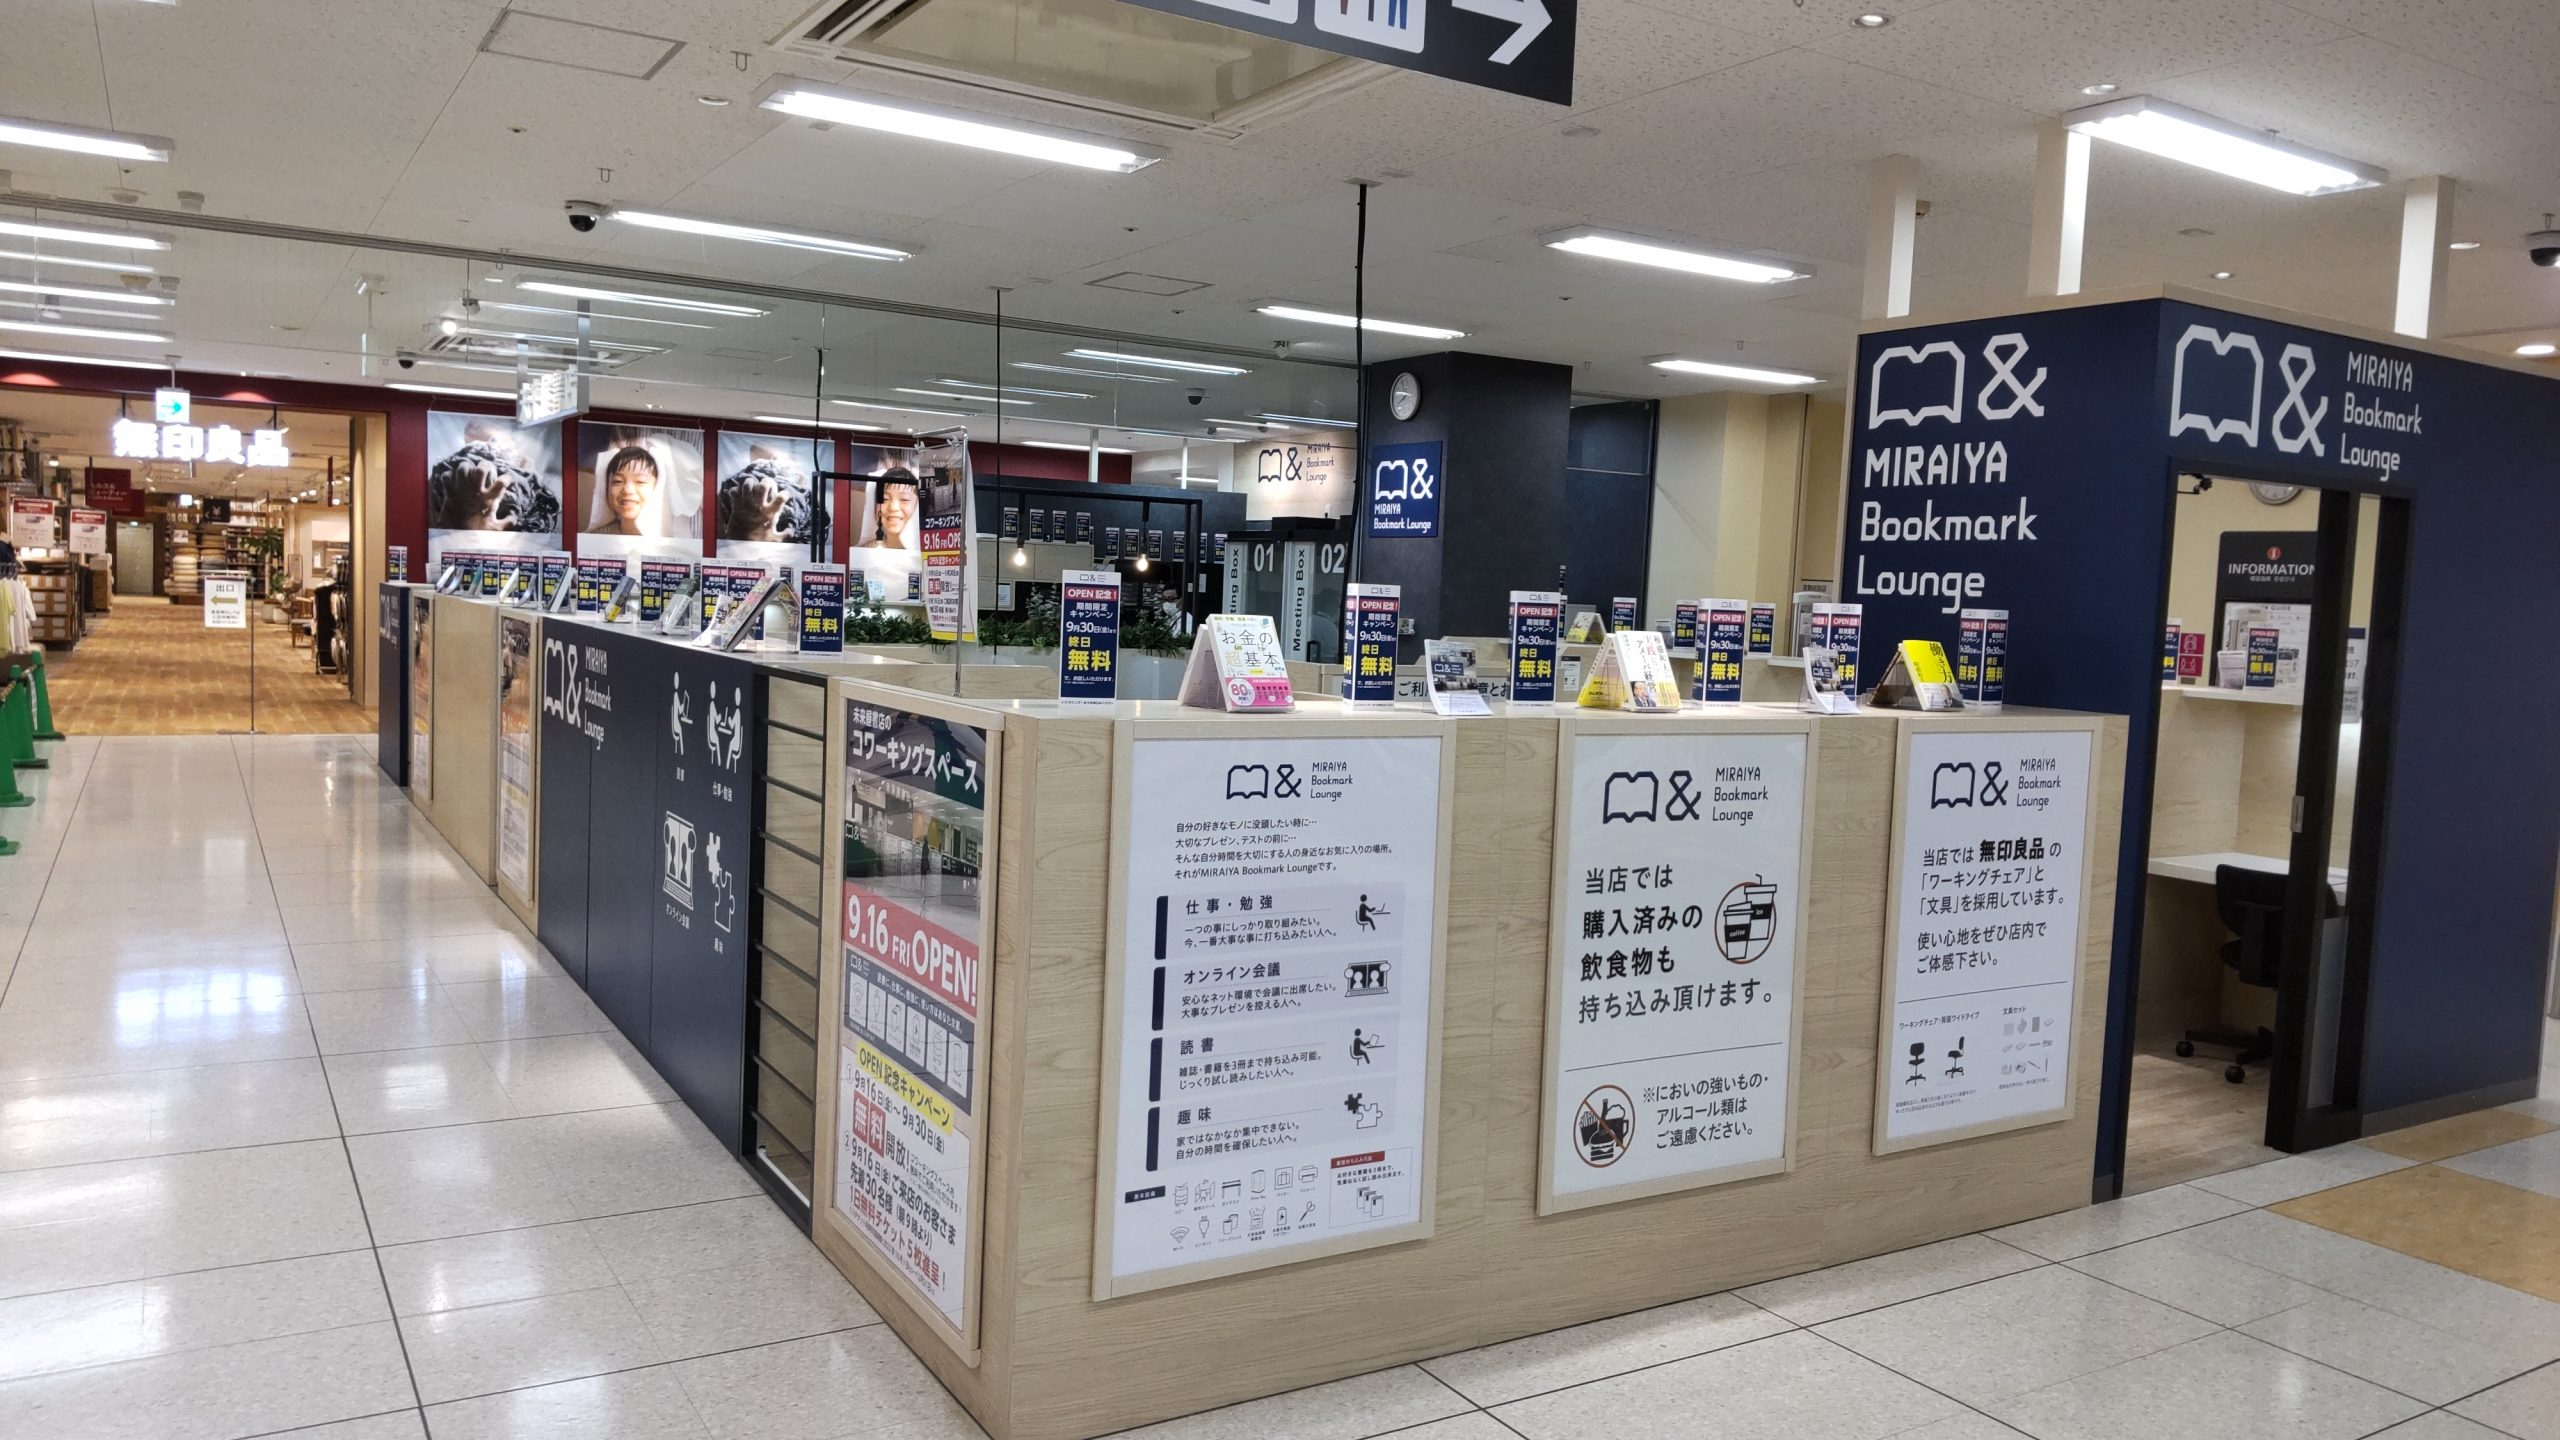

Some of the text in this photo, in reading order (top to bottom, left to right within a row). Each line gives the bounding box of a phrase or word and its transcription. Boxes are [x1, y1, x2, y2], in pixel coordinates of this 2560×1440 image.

[2346, 351, 2413, 393] MIRAIYA
[2344, 392, 2422, 435] Bookmark
[112, 417, 289, 468] 無印良品
[1307, 442, 1331, 453] MIRAIYA
[1306, 456, 1334, 469] Bookmark
[1864, 440, 2007, 488] MIRAIYA
[2340, 432, 2401, 482] Lounge
[1306, 471, 1327, 484] Lounge
[1374, 503, 1401, 515] MIRAIYA
[1860, 496, 2038, 541] Bookmark
[1374, 518, 1432, 533] Bookmark Lounge
[924, 533, 940, 550] 9.16
[1230, 548, 1239, 579] Box
[1253, 543, 1274, 573] 01
[1320, 543, 1346, 574] 02
[1068, 589, 1117, 600] OPEN 記念！
[1857, 555, 1985, 614] Lounge
[1076, 602, 1108, 611] 期間限定
[1293, 549, 1304, 652] Meeting Box
[1361, 601, 1382, 609] OPEN
[1519, 607, 1540, 615] OPEN
[1070, 610, 1113, 619] キャンペーン
[1068, 636, 1091, 647] 終日
[1221, 629, 1273, 646] お金の
[585, 645, 608, 677] MIRAIYA
[1068, 649, 1111, 671] 無料
[1360, 656, 1393, 676] 無料
[585, 677, 612, 713] Bookmark
[584, 709, 605, 751] Lounge
[853, 730, 978, 794] コワーキングスペース
[1312, 761, 1348, 773] MIRAIYA
[2020, 758, 2056, 772] MIRAIYA
[1311, 774, 1353, 786] Bookmark
[1715, 766, 1761, 782] MIRAIYA
[2018, 774, 2061, 790] Bookmark
[1310, 788, 1342, 802] Lounge
[1714, 785, 1769, 802] Bookmark
[2016, 792, 2049, 811] Lounge
[1176, 817, 1317, 833] 自分の好きなモノに没頭したい時に…
[1712, 806, 1754, 826] Lounge
[1175, 833, 1297, 848] 大切なプレゼン、テストの前に…
[1174, 844, 1392, 864] そんな自分時間を大切にする人の身近なお気に入りの場所。
[1922, 837, 2062, 868] 当店では 無印良品 の
[1242, 863, 1285, 876] Bookmark
[1286, 861, 1337, 874] Loungeです。
[1585, 865, 1674, 895] 当店では
[1921, 865, 2045, 892] 「ワーキングチェア」と
[1920, 888, 2065, 916] 「文具」を採用しています。
[1184, 917, 1320, 934] 一つの事にしっかり取り組みたい。
[1582, 905, 1703, 940] 購入済みの
[1184, 928, 1337, 949] 今、一番大事な事に打ち込みたい人へ。
[1917, 922, 2047, 950] 使い心地をぜひ店内で
[848, 894, 978, 1007] 9.16 FRI OPEN!
[1183, 962, 1281, 985] オンライン会議
[1580, 945, 1676, 983] 飲食物も
[1916, 950, 1999, 975] ご体感下さい。
[1181, 982, 1336, 1007] 安心なネット環境で会議に出席したい。
[1578, 978, 1772, 1024] 持ち込み頂けます。
[1181, 997, 1302, 1019] 大事なプレゼンを控える人へ。
[1180, 1037, 1214, 1055] 読書
[859, 1048, 882, 1079] OPEN
[1179, 1067, 1295, 1090] じっくり試し読みしたい人へ。
[1642, 1072, 1769, 1102] ※においの強いもの・
[1177, 1107, 1212, 1125] 趣味
[1656, 1097, 1747, 1126] アルコール類は
[854, 1098, 884, 1150] 無料
[1176, 1121, 1299, 1147] 家ではなかなか集中できない。
[1176, 1134, 1297, 1160] 自分の時間を確保したい人へ。
[1656, 1122, 1754, 1150] ご遠慮ください。
